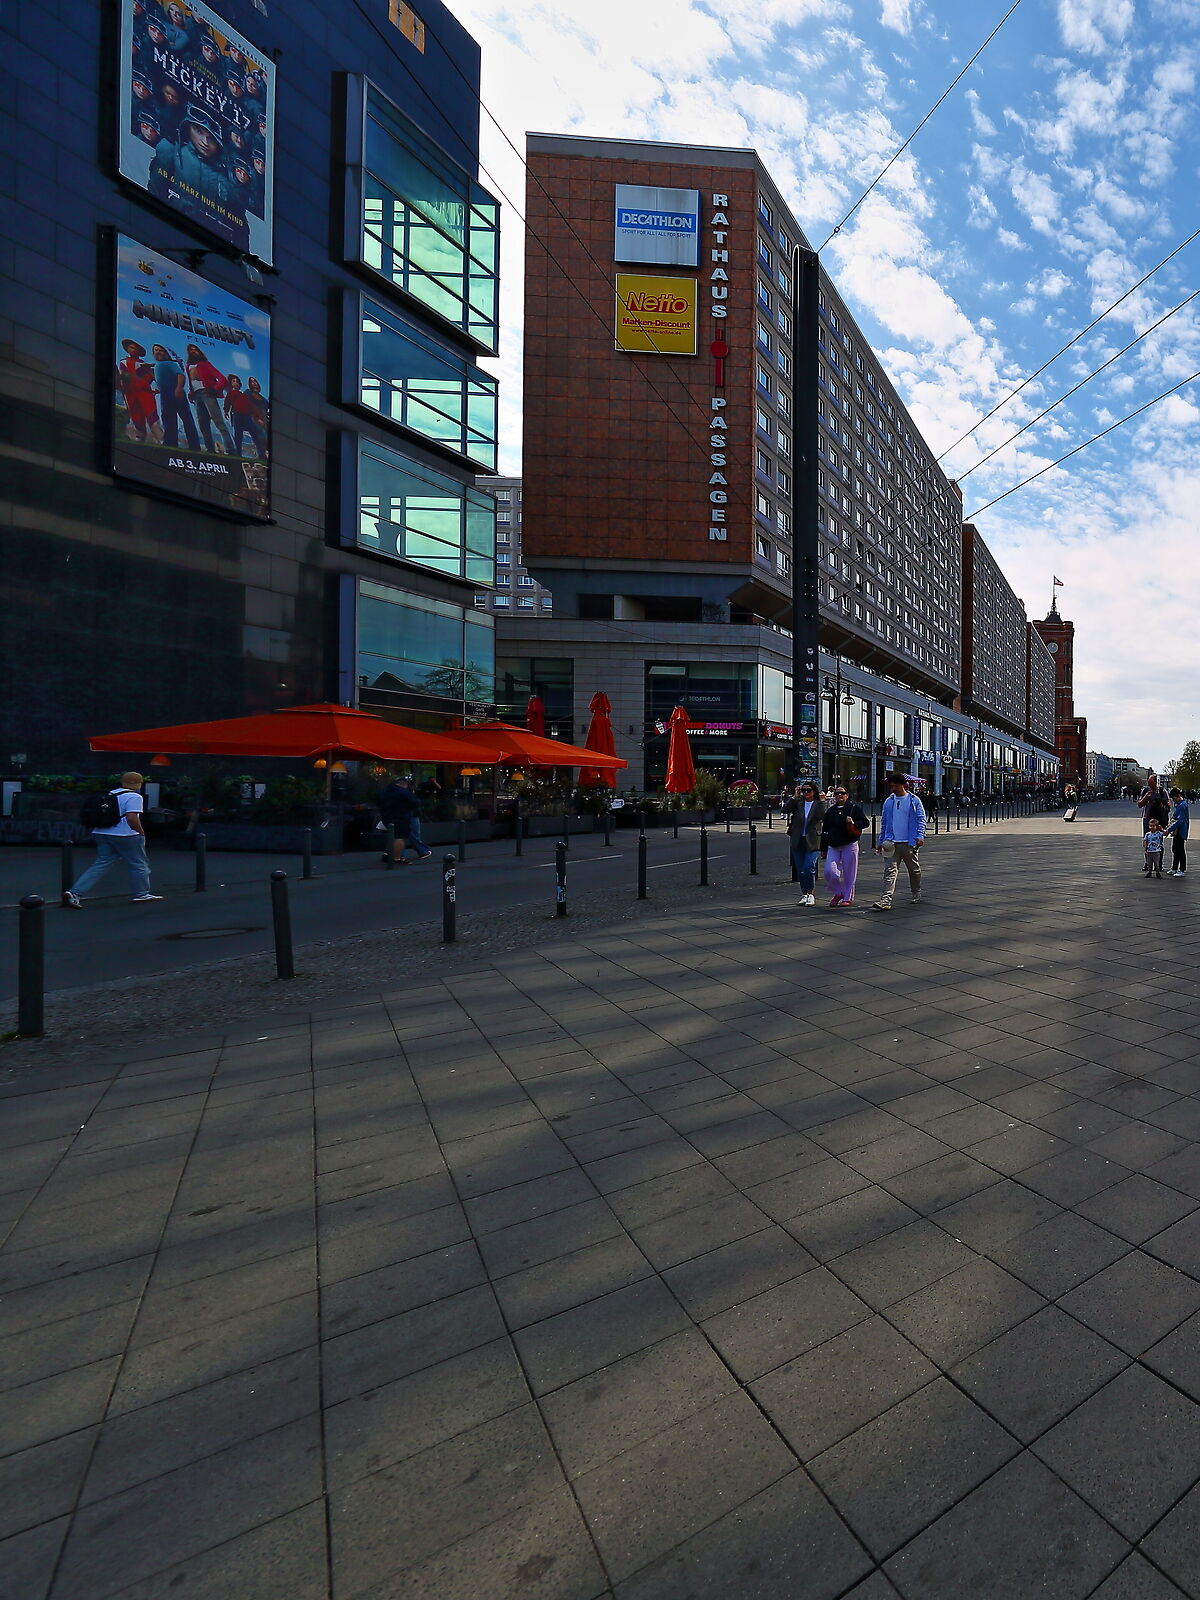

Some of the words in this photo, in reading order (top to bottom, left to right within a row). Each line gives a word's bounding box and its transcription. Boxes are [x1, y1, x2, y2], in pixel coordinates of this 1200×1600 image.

[154, 47, 227, 113] MICKEY
[233, 108, 251, 130] 17
[157, 167, 168, 180] AB
[201, 195, 216, 211] NUR
[217, 206, 226, 216] IM
[621, 212, 692, 229] DECATHLON
[710, 193, 729, 319] RATHAUS
[627, 291, 689, 314] Netto
[622, 317, 691, 328] Marken-Discount
[168, 457, 184, 468] AB
[186, 460, 197, 470] 3.
[199, 462, 229, 474] APRIL
[708, 397, 728, 541] PASSAGEN
